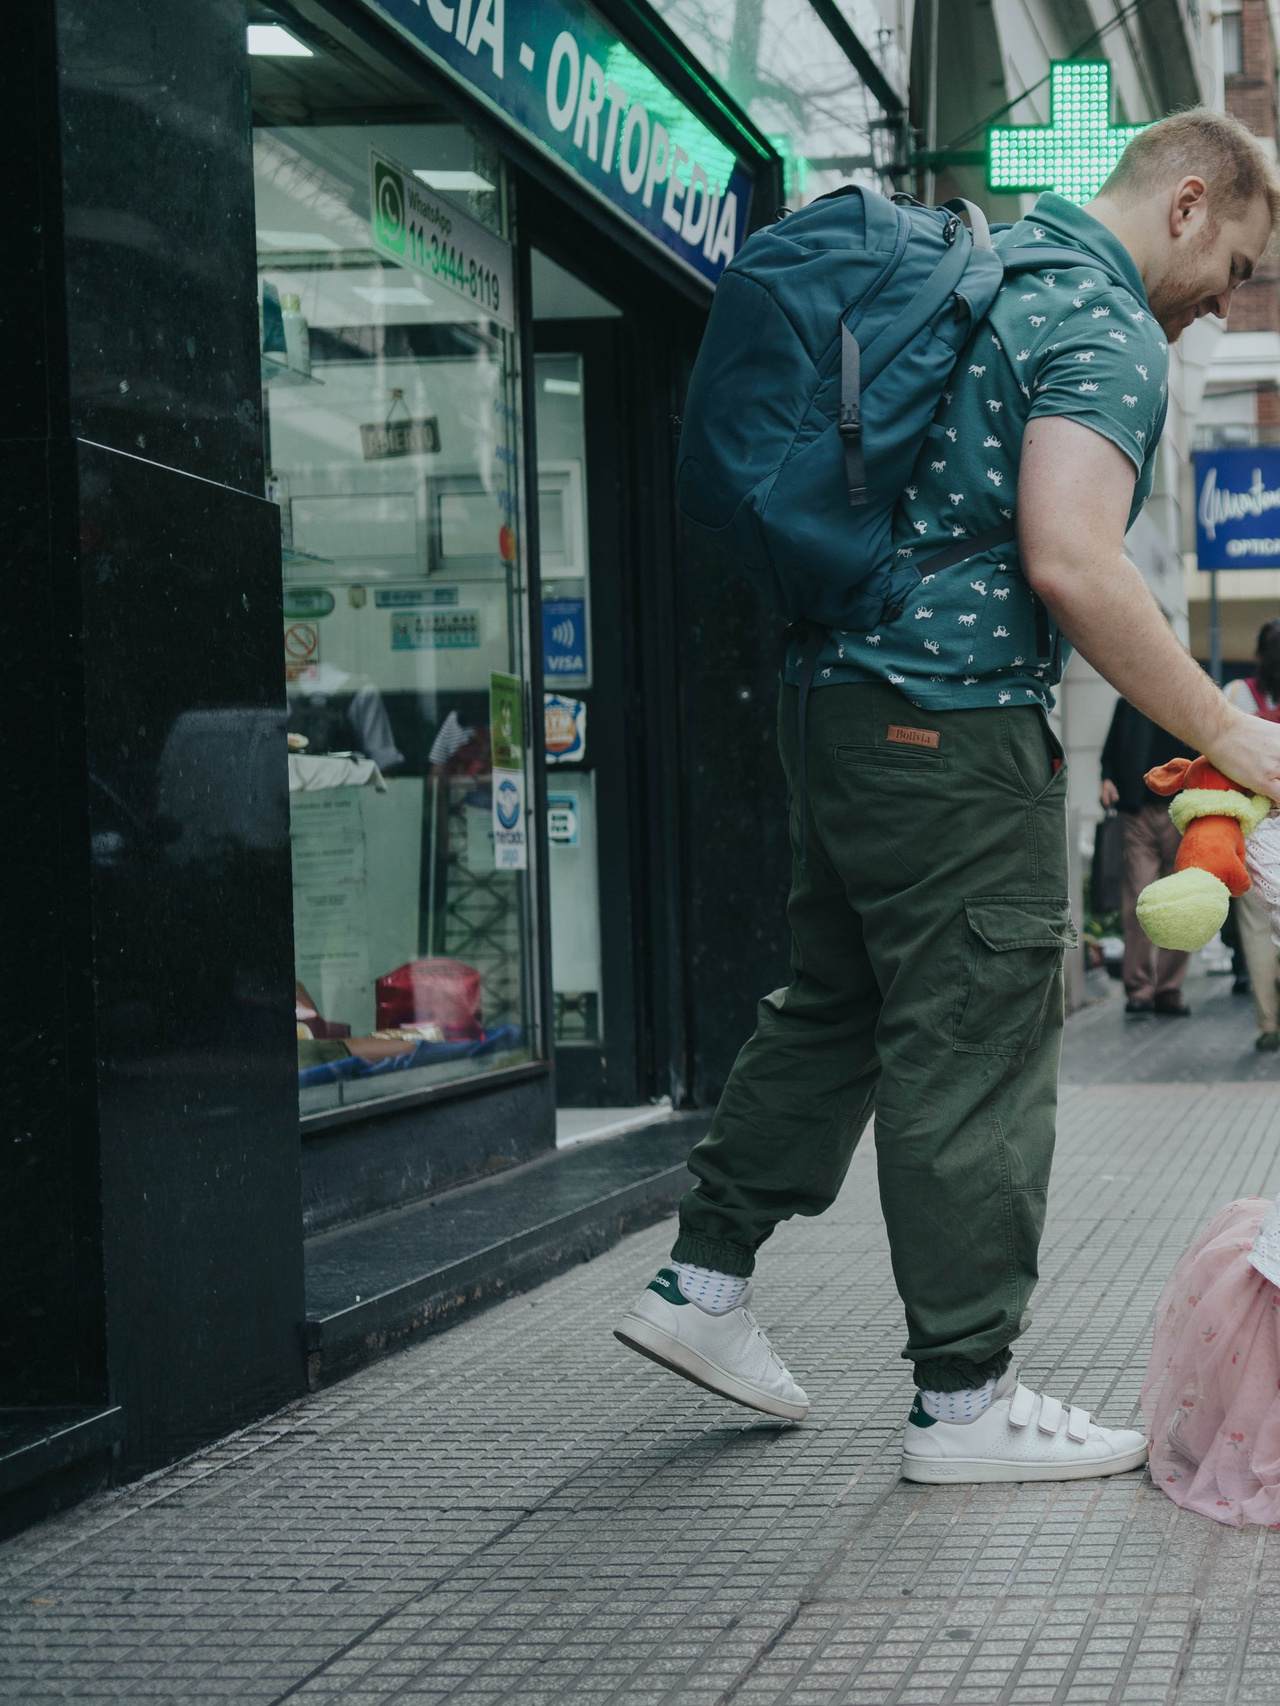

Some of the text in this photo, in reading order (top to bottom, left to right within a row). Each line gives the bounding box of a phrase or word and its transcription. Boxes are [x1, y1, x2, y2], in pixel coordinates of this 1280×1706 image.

[546, 30, 738, 267] ORTOPEDIA
[407, 187, 453, 236] WhatsApp
[409, 219, 500, 311] 11-3444-8119
[547, 655, 584, 671] VISA
[896, 729, 931, 744] Bolivia
